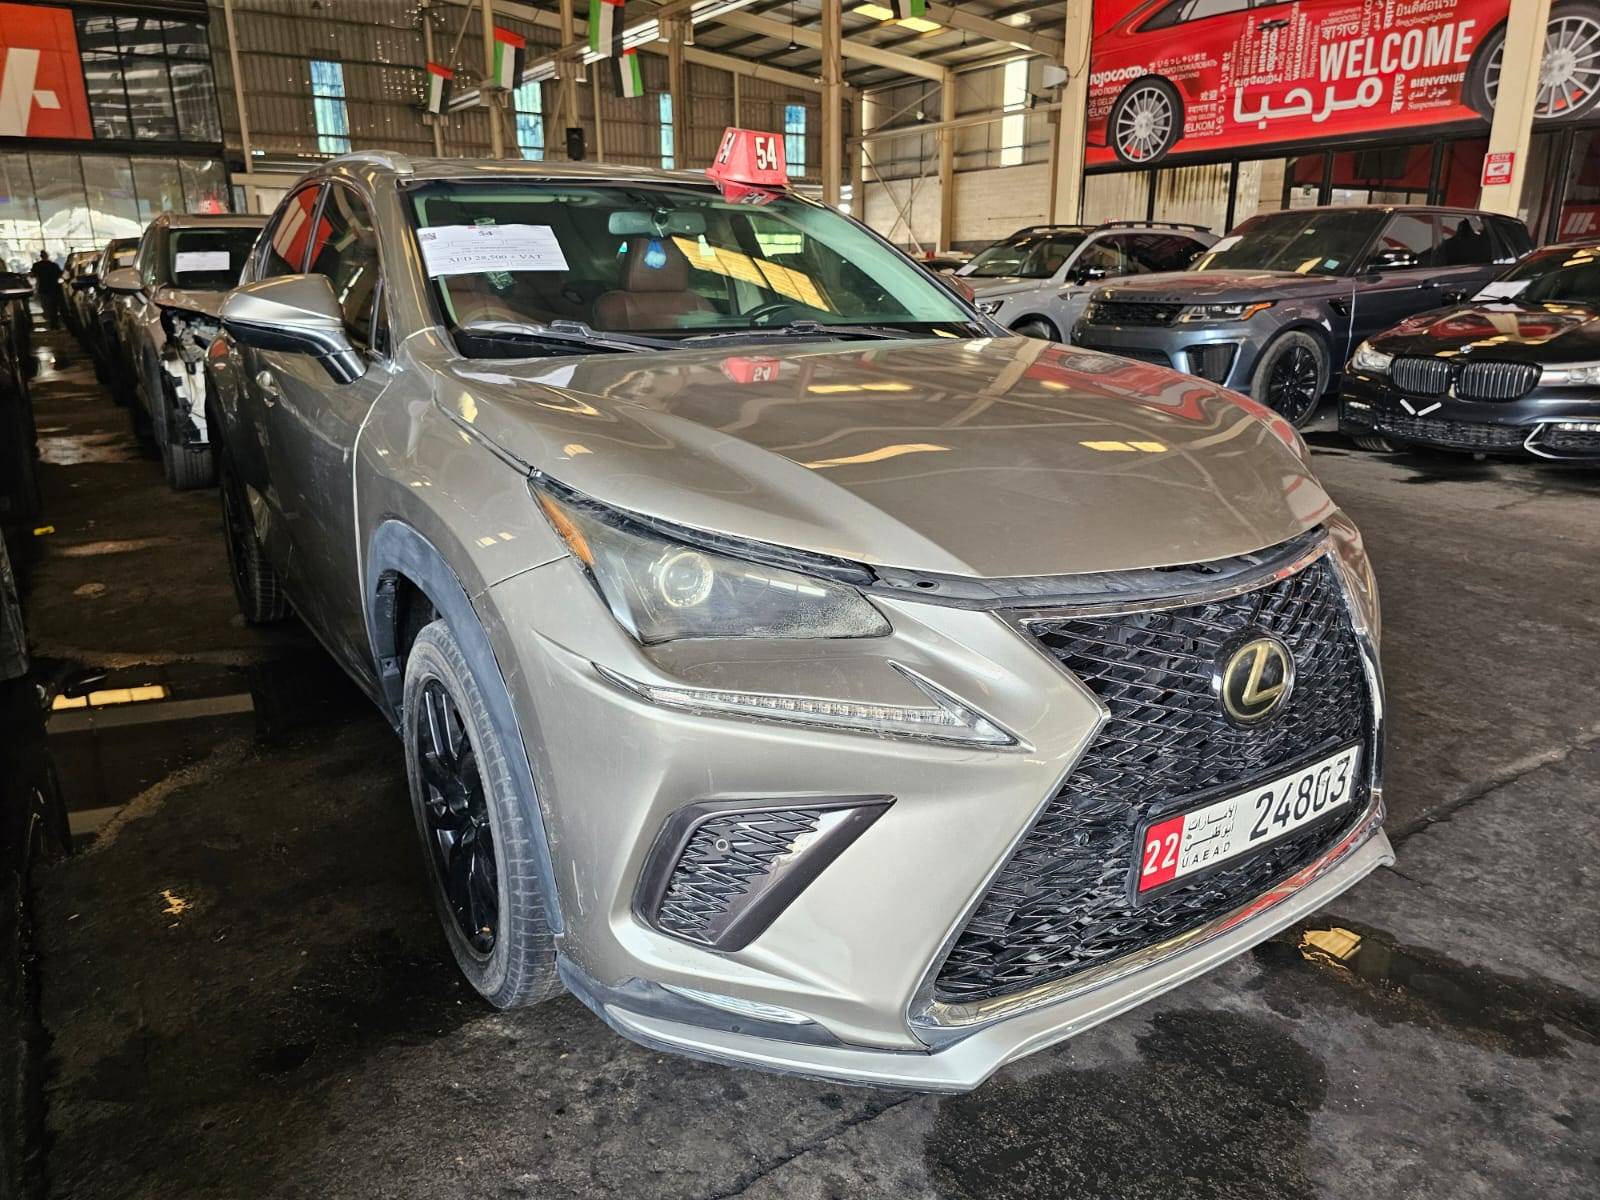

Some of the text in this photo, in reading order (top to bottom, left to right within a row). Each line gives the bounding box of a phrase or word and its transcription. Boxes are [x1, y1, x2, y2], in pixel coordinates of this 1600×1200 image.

[1293, 13, 1307, 80] WILLKOMMEN
[1319, 19, 1476, 83] WELCOME
[1234, 77, 1383, 130] مرحبا
[1410, 72, 1465, 88] BIENVENUE
[755, 136, 778, 171] 54
[1249, 756, 1350, 842] 24803
[1143, 832, 1180, 877] 22
